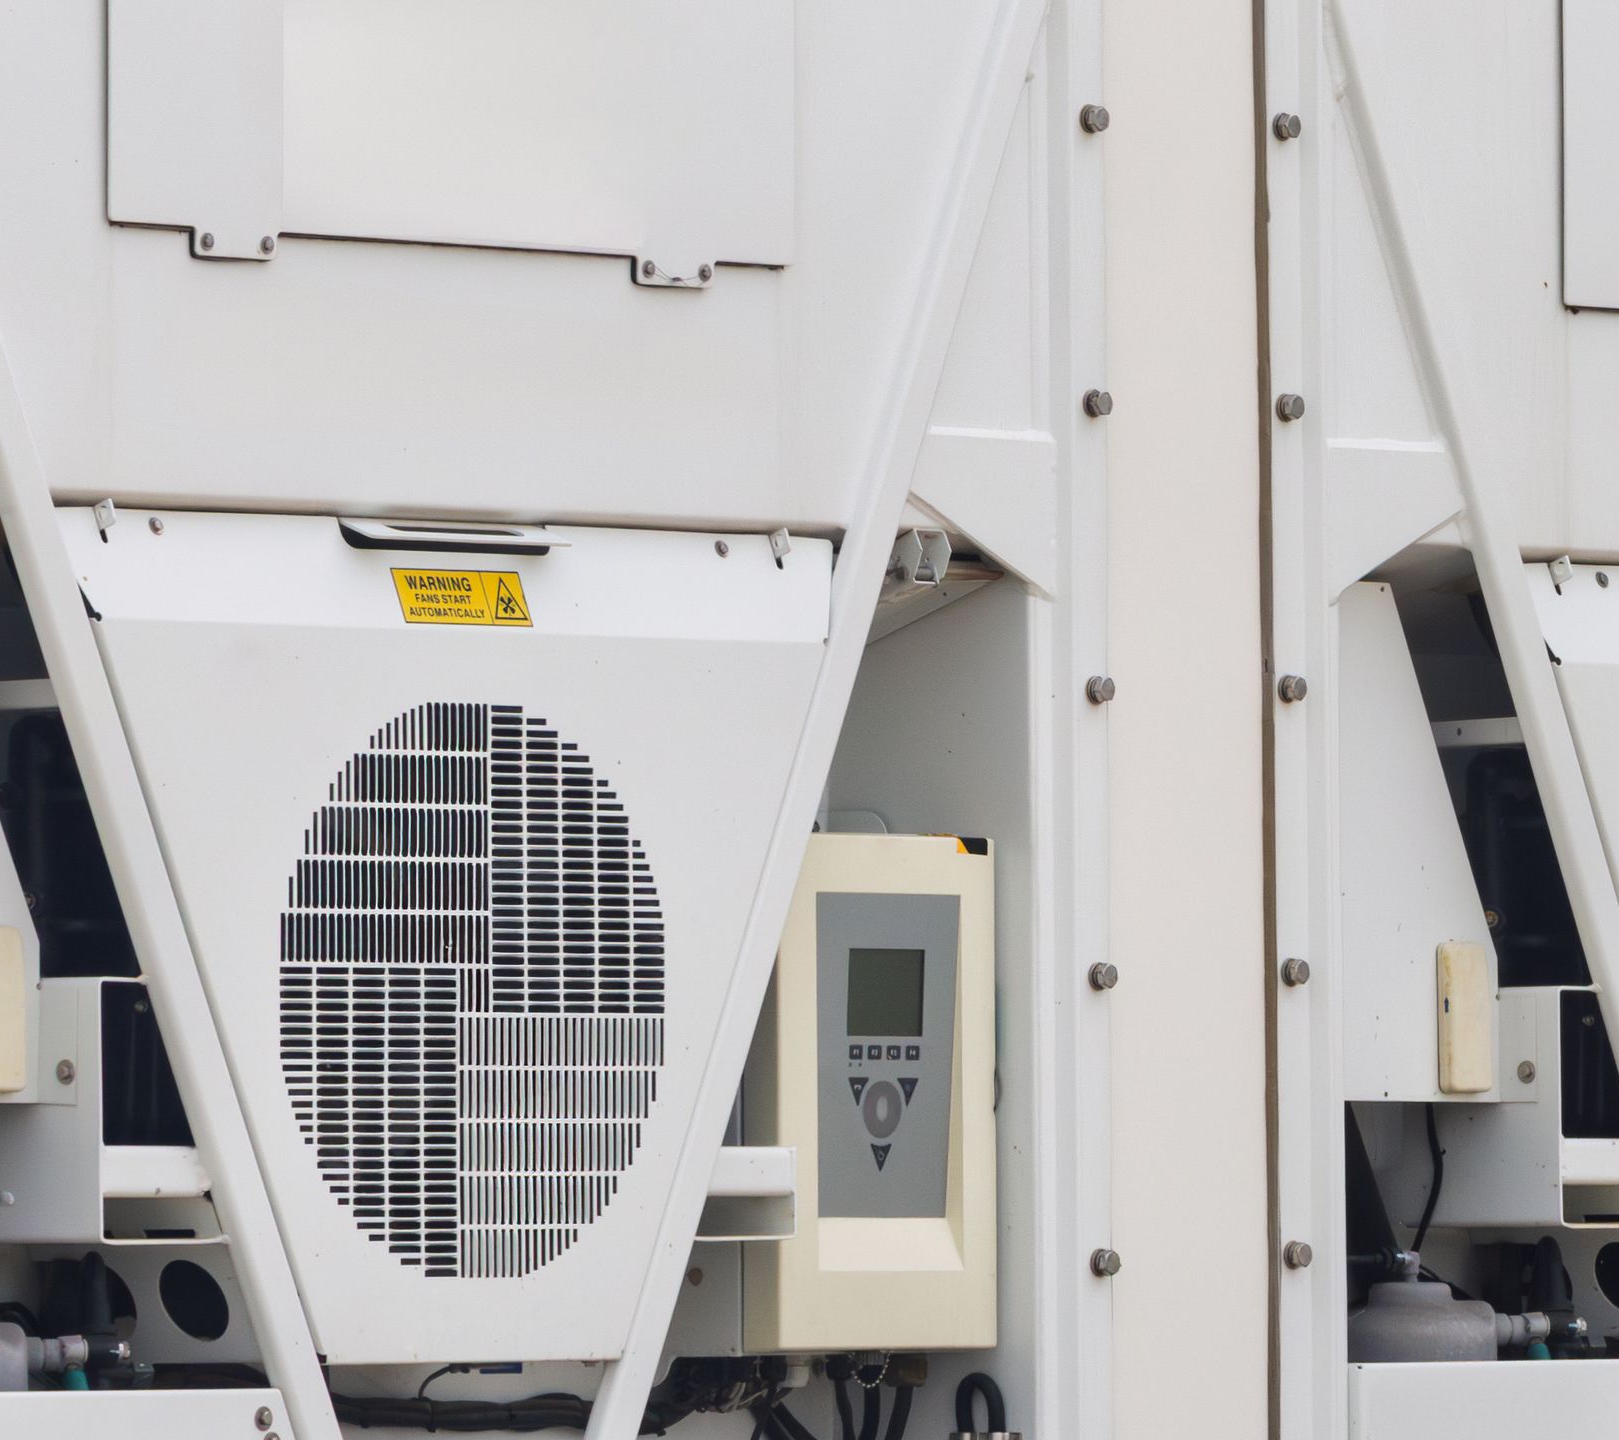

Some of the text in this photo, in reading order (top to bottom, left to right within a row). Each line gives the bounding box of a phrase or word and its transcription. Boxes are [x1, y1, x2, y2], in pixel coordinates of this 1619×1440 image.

[404, 575, 472, 592] WARNING
[414, 593, 471, 605] FANS START
[409, 607, 485, 619] AUTOMATICALLY
